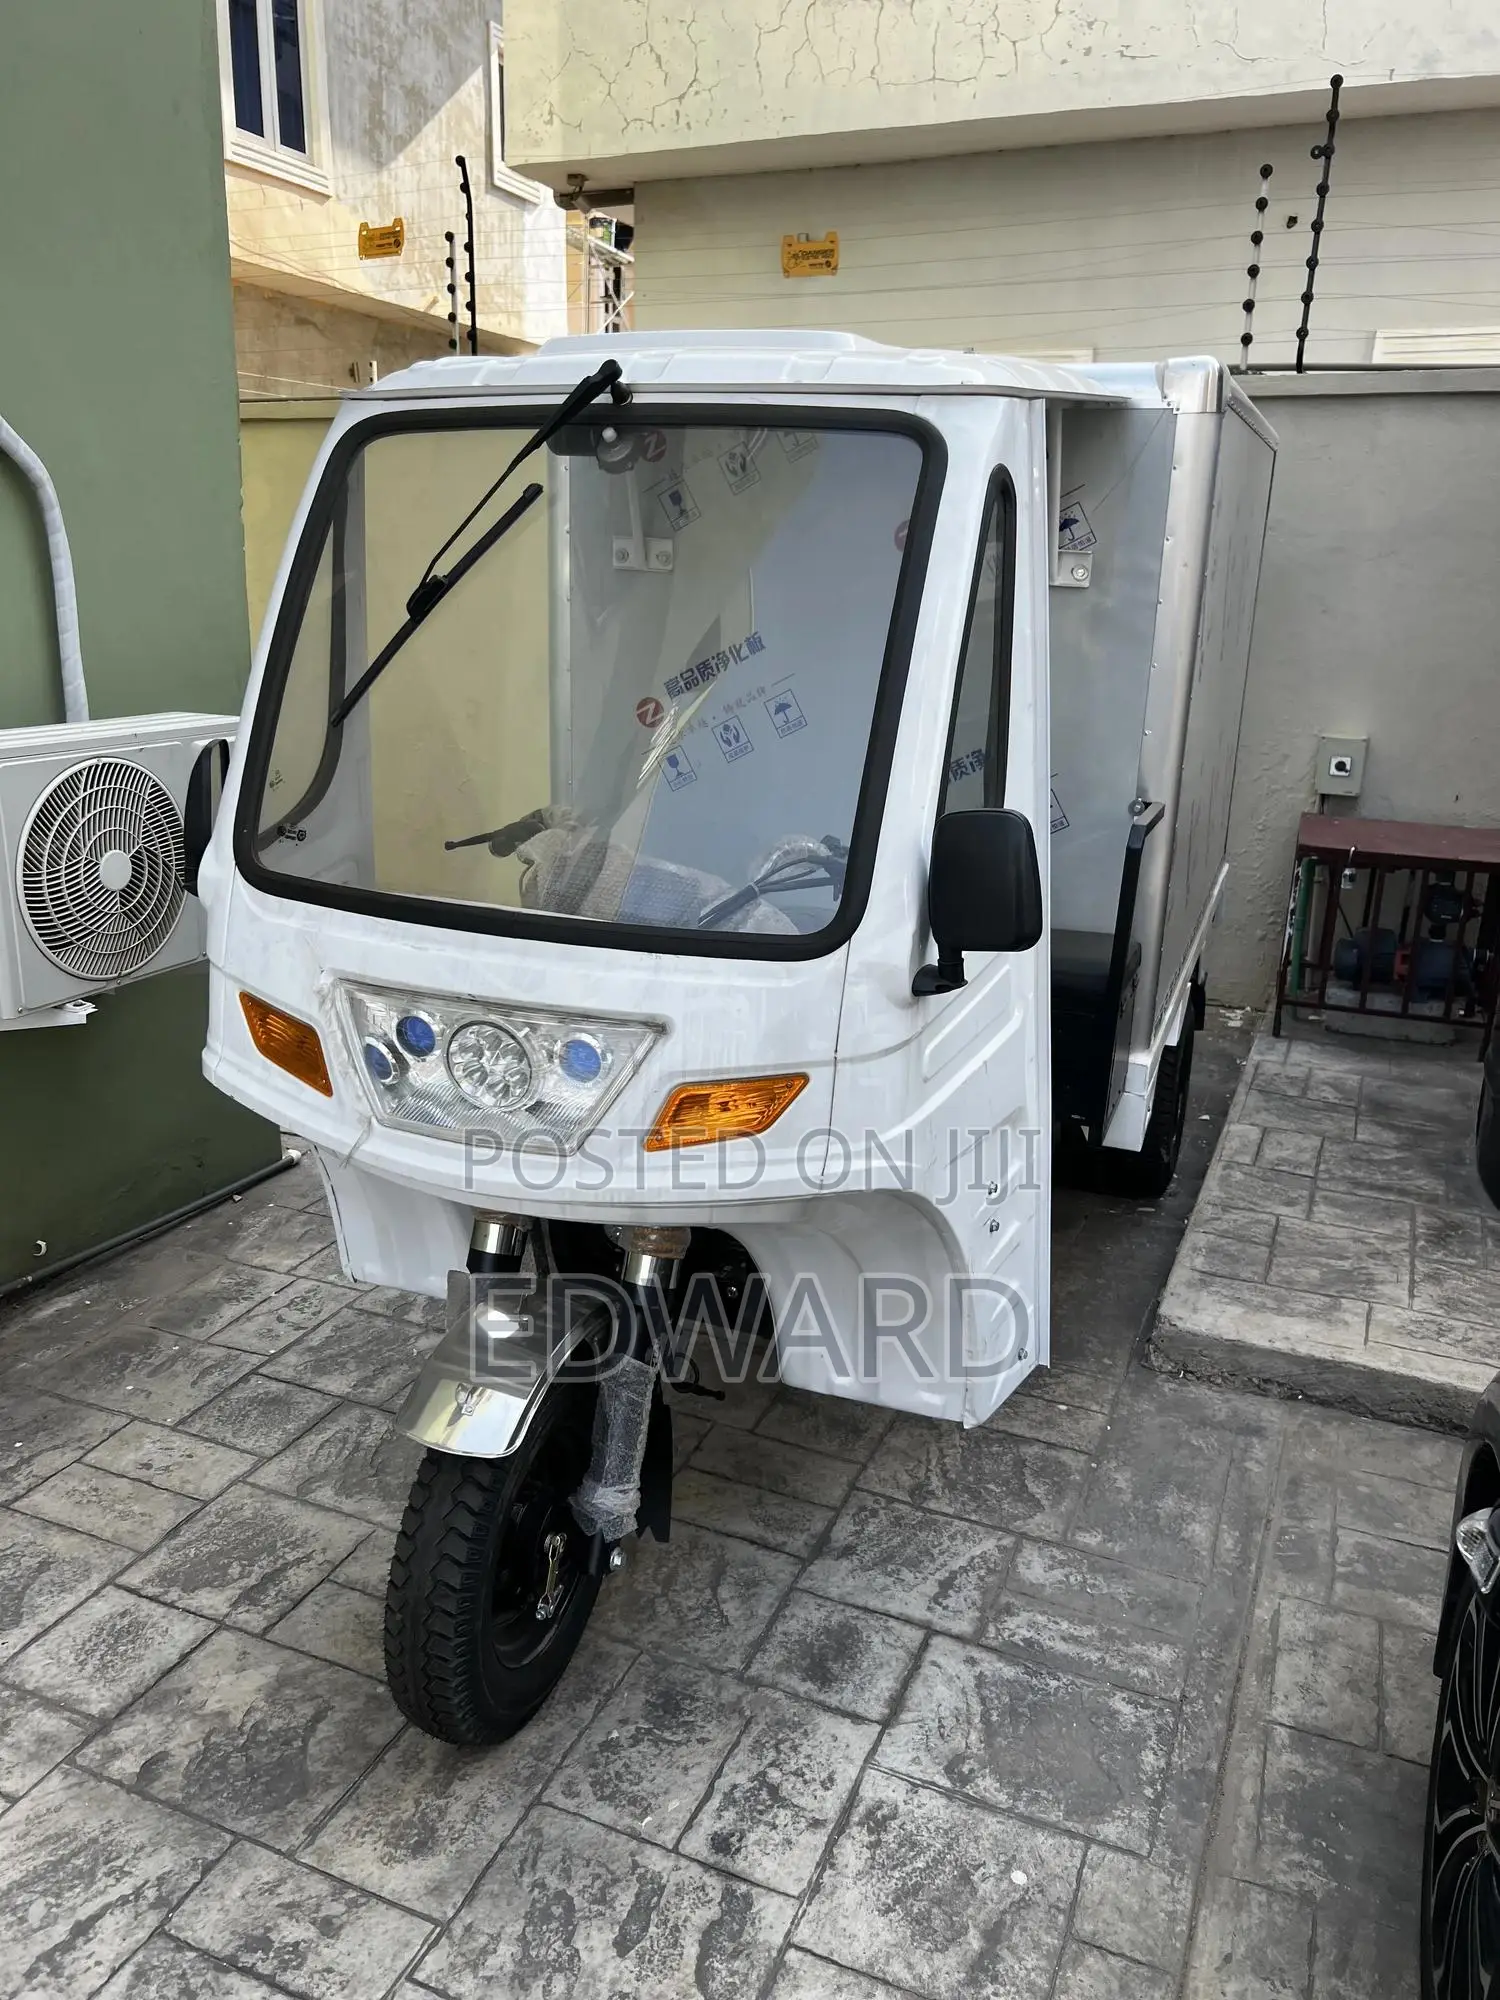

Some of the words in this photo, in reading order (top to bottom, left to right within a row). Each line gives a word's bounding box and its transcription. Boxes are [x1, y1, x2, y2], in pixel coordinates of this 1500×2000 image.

[664, 631, 766, 699] 高品质净化板
